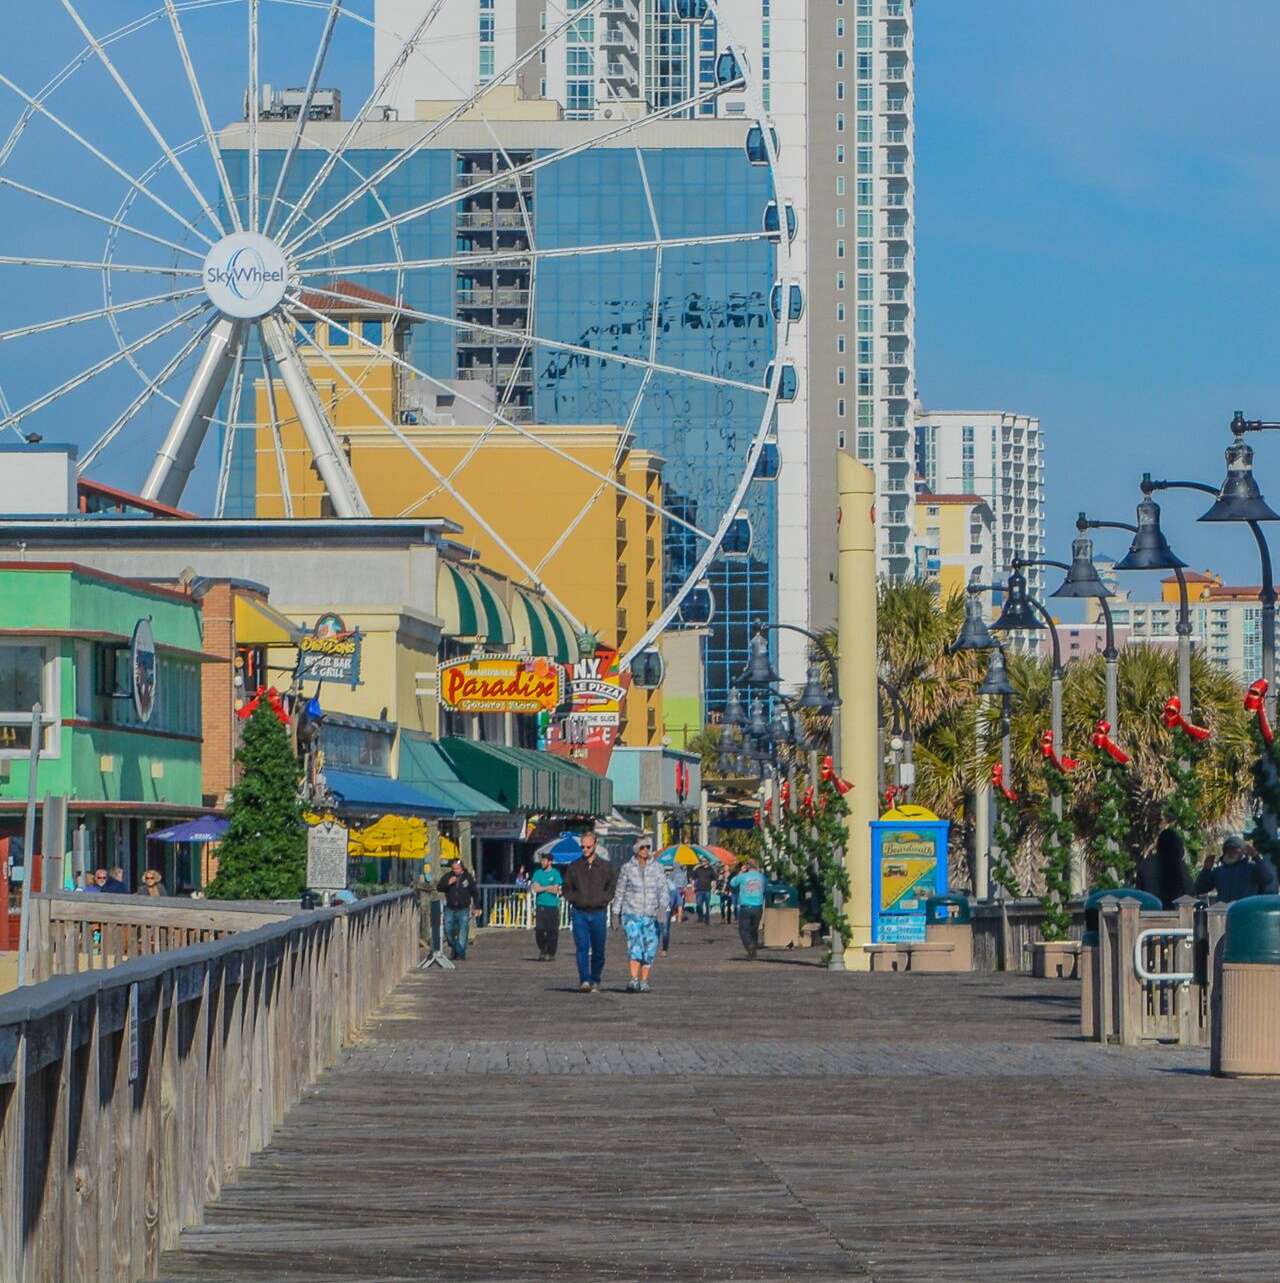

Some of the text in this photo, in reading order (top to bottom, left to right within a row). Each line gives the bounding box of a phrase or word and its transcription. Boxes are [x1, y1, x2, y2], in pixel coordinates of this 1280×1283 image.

[207, 266, 284, 287] SkyWheel
[319, 667, 344, 678] GRILL
[333, 658, 352, 669] BAR
[573, 658, 602, 679] N.Y.
[448, 666, 556, 704] Paradise
[588, 683, 620, 699] PIZZA
